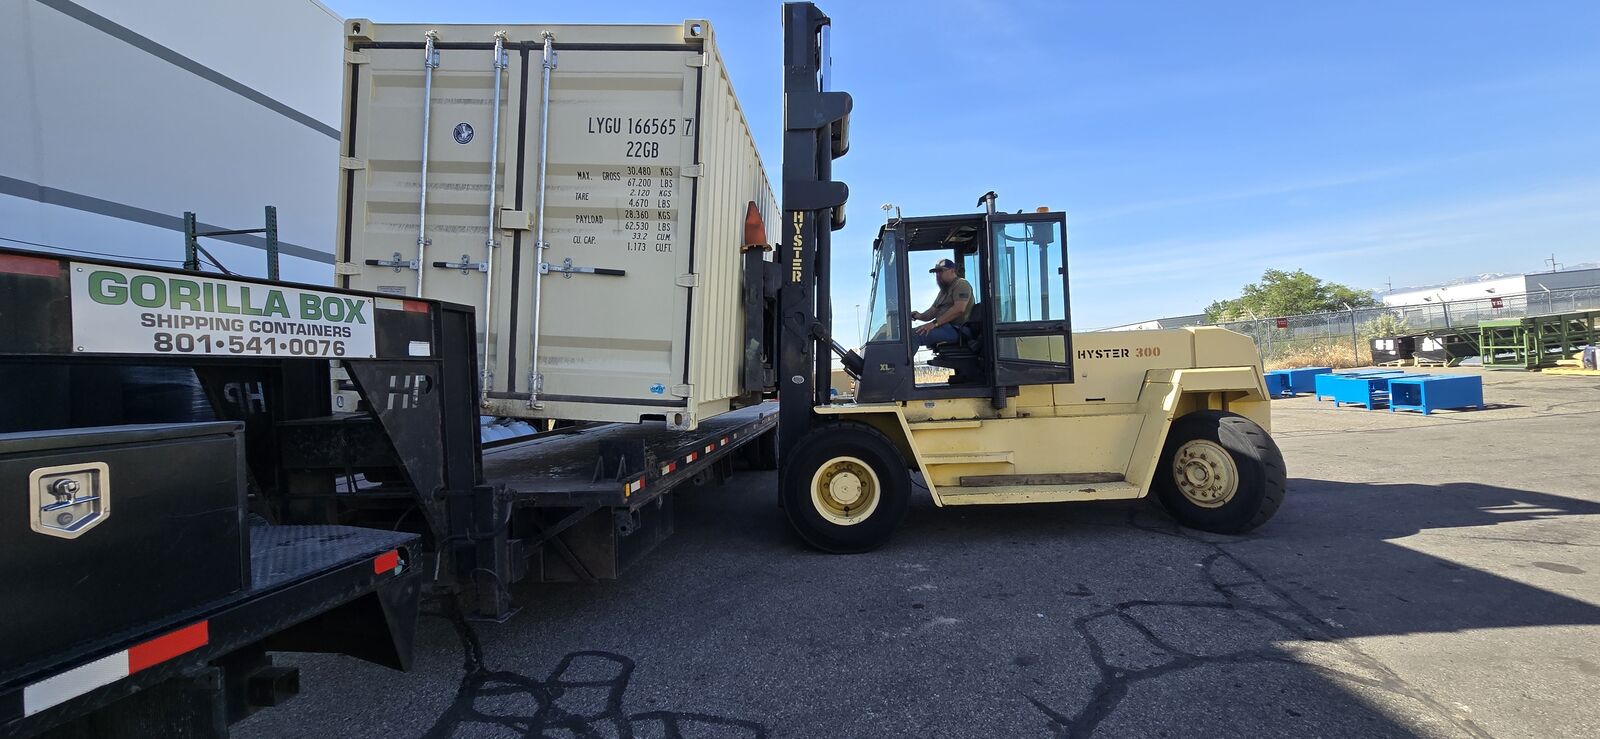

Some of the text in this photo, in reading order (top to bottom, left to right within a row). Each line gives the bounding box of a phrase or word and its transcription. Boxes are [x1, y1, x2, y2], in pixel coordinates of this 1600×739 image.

[588, 117, 693, 136] LYGU 166565 7
[626, 141, 659, 158] 22GB
[577, 171, 621, 181] MAX. GROSS
[627, 166, 673, 176] 30.480 KGS
[627, 179, 673, 188] 67.200 LBS
[575, 192, 589, 200] TARE
[629, 189, 650, 197] 2.120
[628, 199, 671, 208] 4.670 LBS
[575, 214, 604, 224] PAYLOAD
[625, 209, 671, 220] 28.360 KGS
[625, 221, 671, 231] 62.530 LBS
[584, 236, 597, 245] CAP.
[632, 232, 648, 240] 33.2
[627, 242, 646, 251] 1.173
[792, 211, 804, 282] HYSTER
[87, 270, 367, 325] GORILLA BOX
[140, 312, 352, 339] SHIPPING CONTAINERS
[1077, 346, 1161, 360] HYSTER 300
